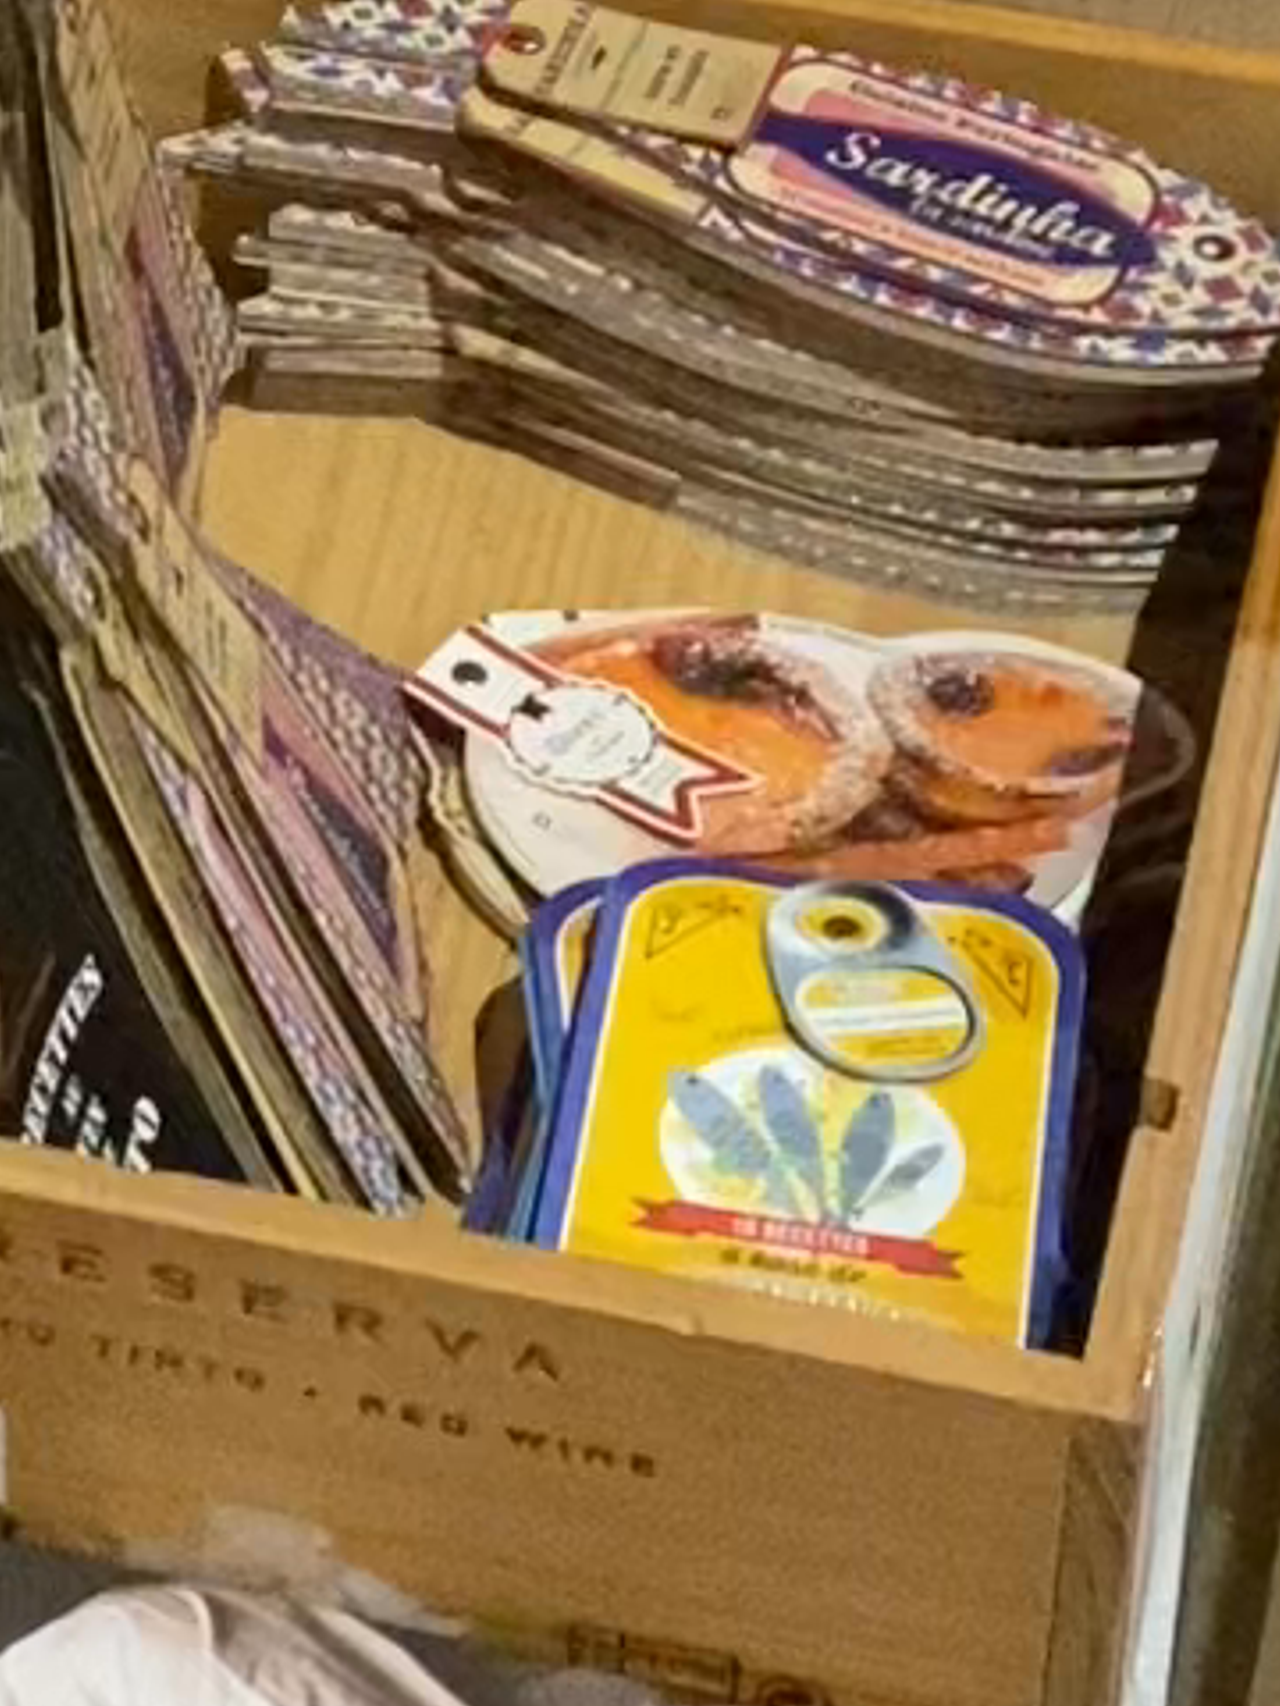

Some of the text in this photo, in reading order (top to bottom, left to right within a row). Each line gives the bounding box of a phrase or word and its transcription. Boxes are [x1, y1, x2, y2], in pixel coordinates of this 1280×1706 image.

[824, 131, 1118, 257] Sardinha
[92, 1332, 269, 1395] TINTO
[357, 1393, 469, 1439] RED
[504, 1421, 660, 1480] WINE
